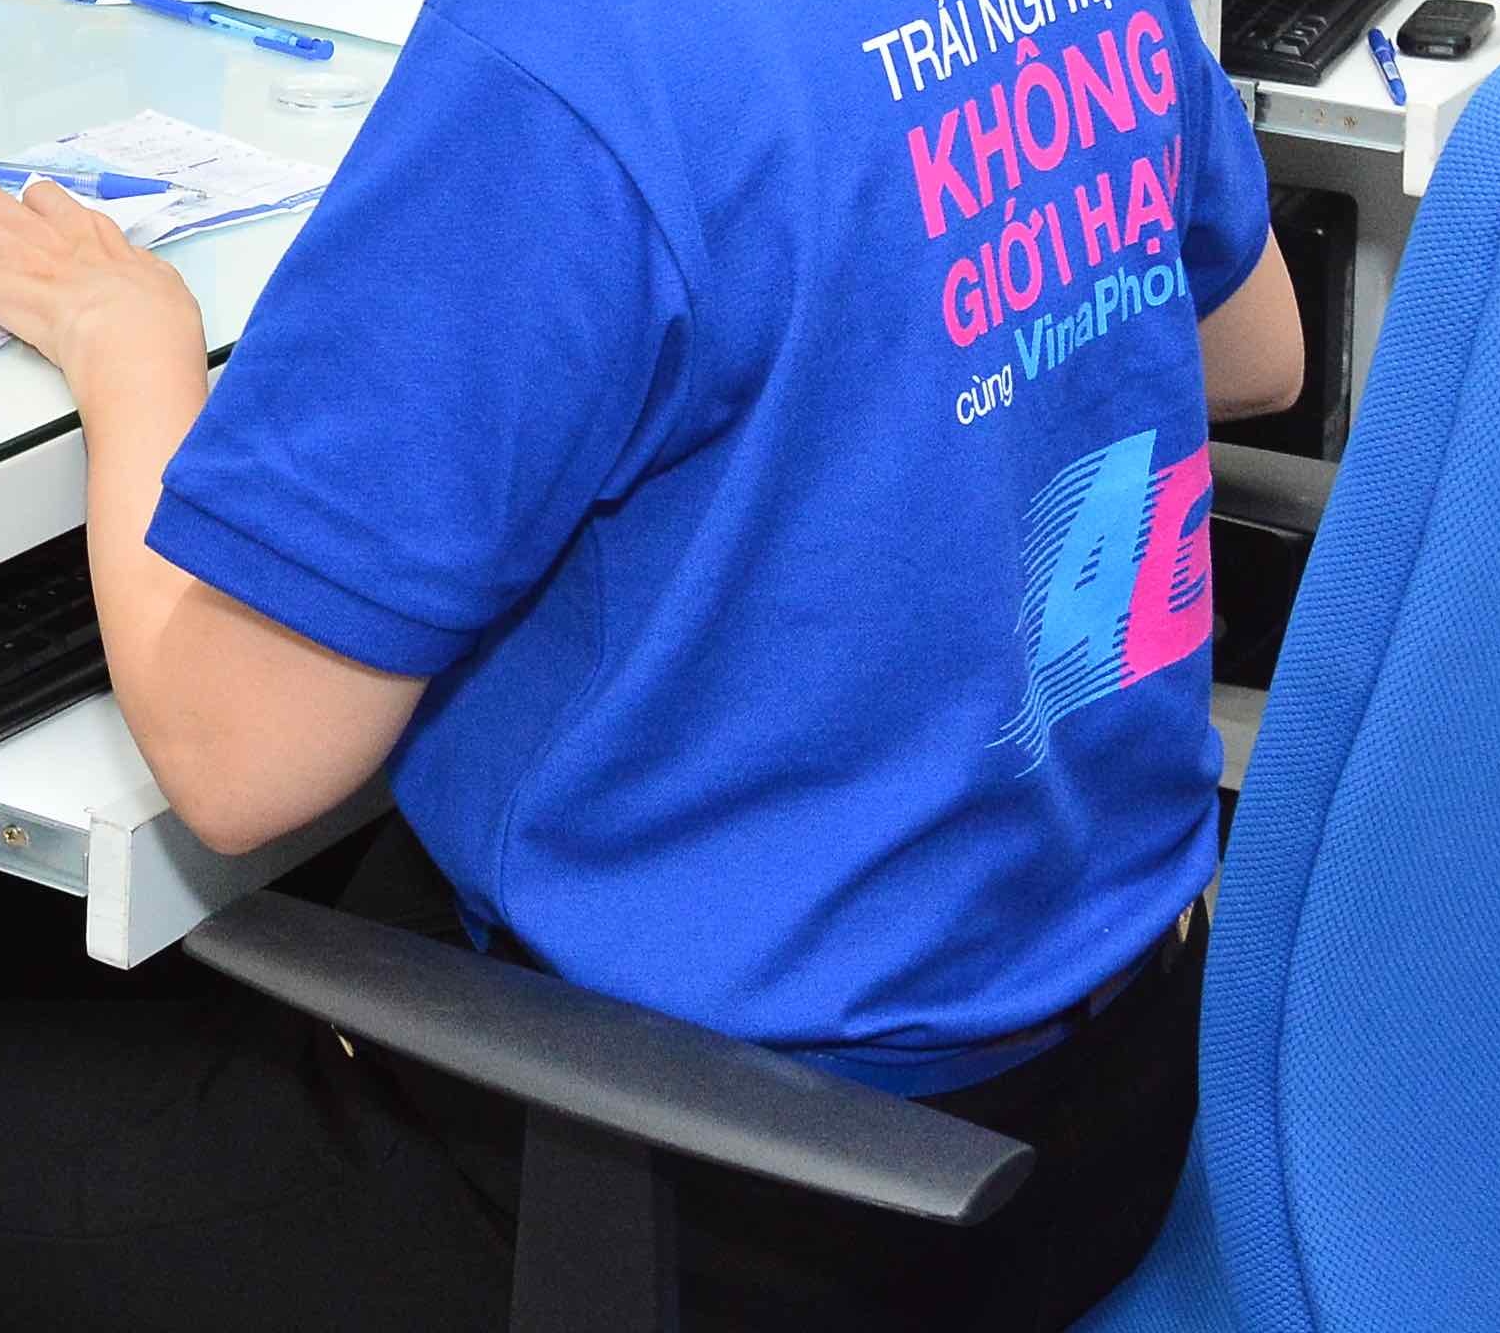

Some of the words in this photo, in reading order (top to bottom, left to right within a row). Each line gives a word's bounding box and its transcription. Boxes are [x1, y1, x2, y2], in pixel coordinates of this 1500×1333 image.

[907, 9, 1176, 238] KHÔNG
[940, 203, 1075, 349] GIỚI
[956, 361, 1014, 425] cùng
[1014, 254, 1188, 385] VinaPho
